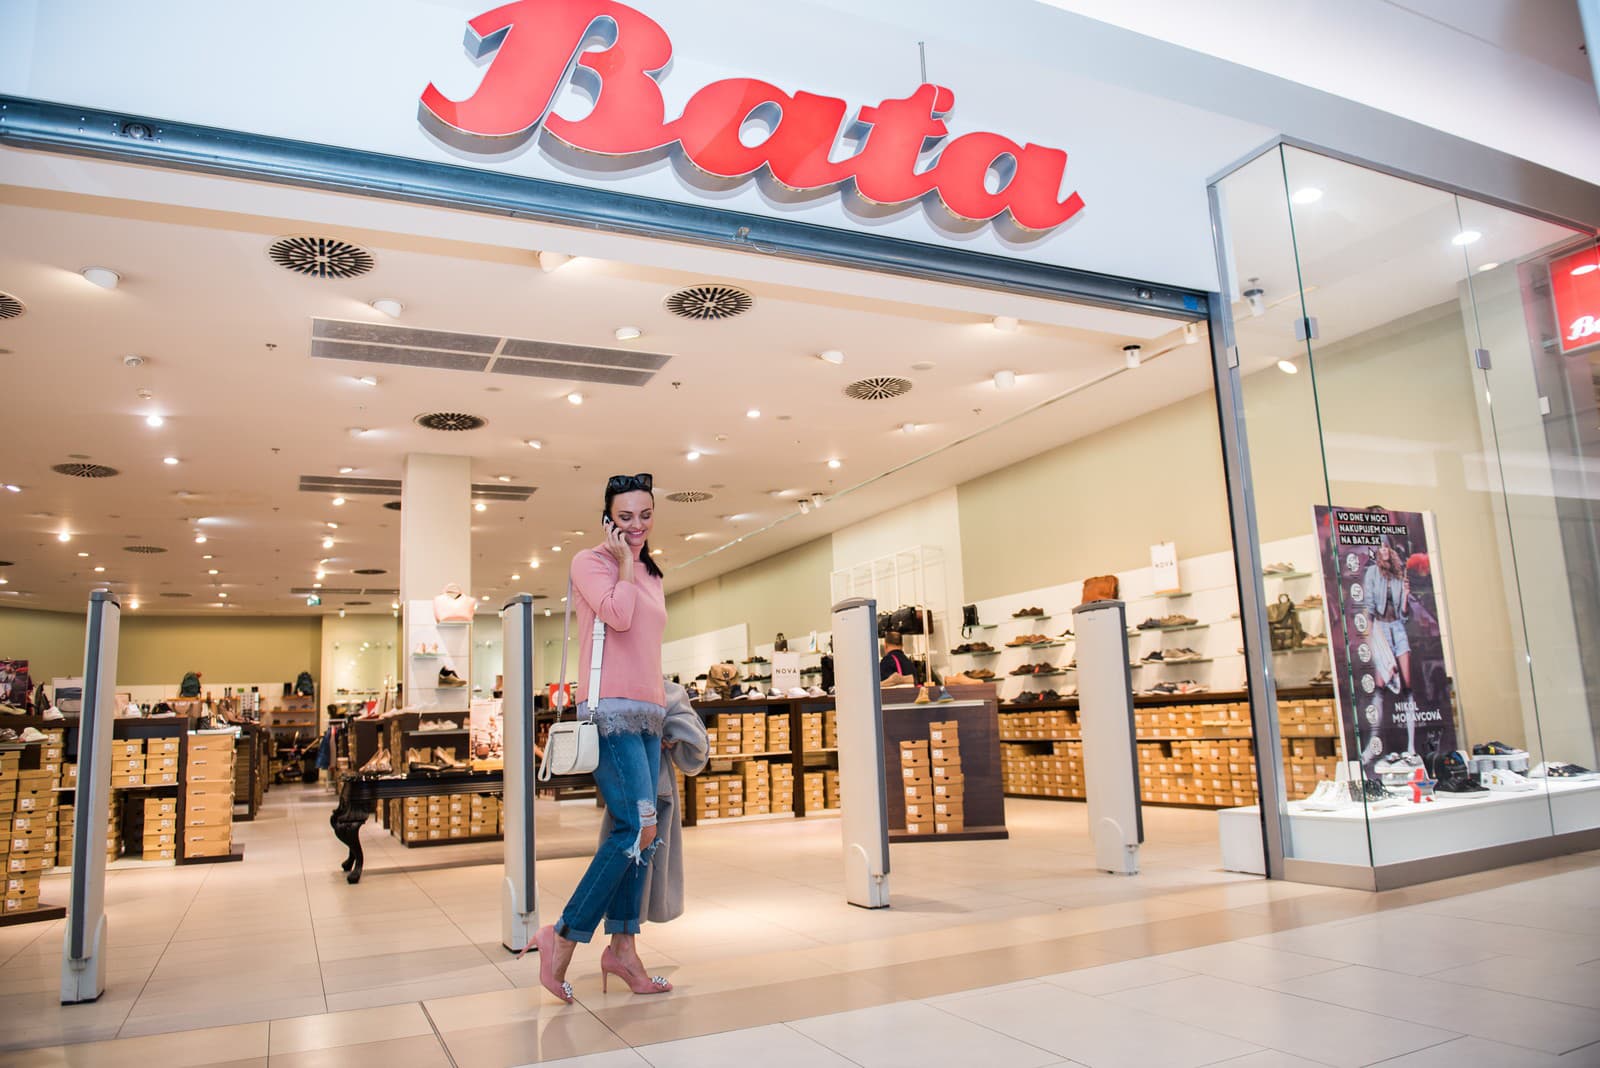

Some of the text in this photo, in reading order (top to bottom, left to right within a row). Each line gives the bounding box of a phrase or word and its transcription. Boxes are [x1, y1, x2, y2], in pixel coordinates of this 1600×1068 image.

[419, 0, 1085, 231] Bata
[1349, 513, 1363, 522] DNE
[1364, 514, 1369, 522] V
[1370, 514, 1388, 522] NOCI
[1339, 524, 1406, 535] NAKUPUJEM ONLINE
[1341, 535, 1380, 544] NA BATA.SK
[1394, 701, 1419, 712] NIKOL
